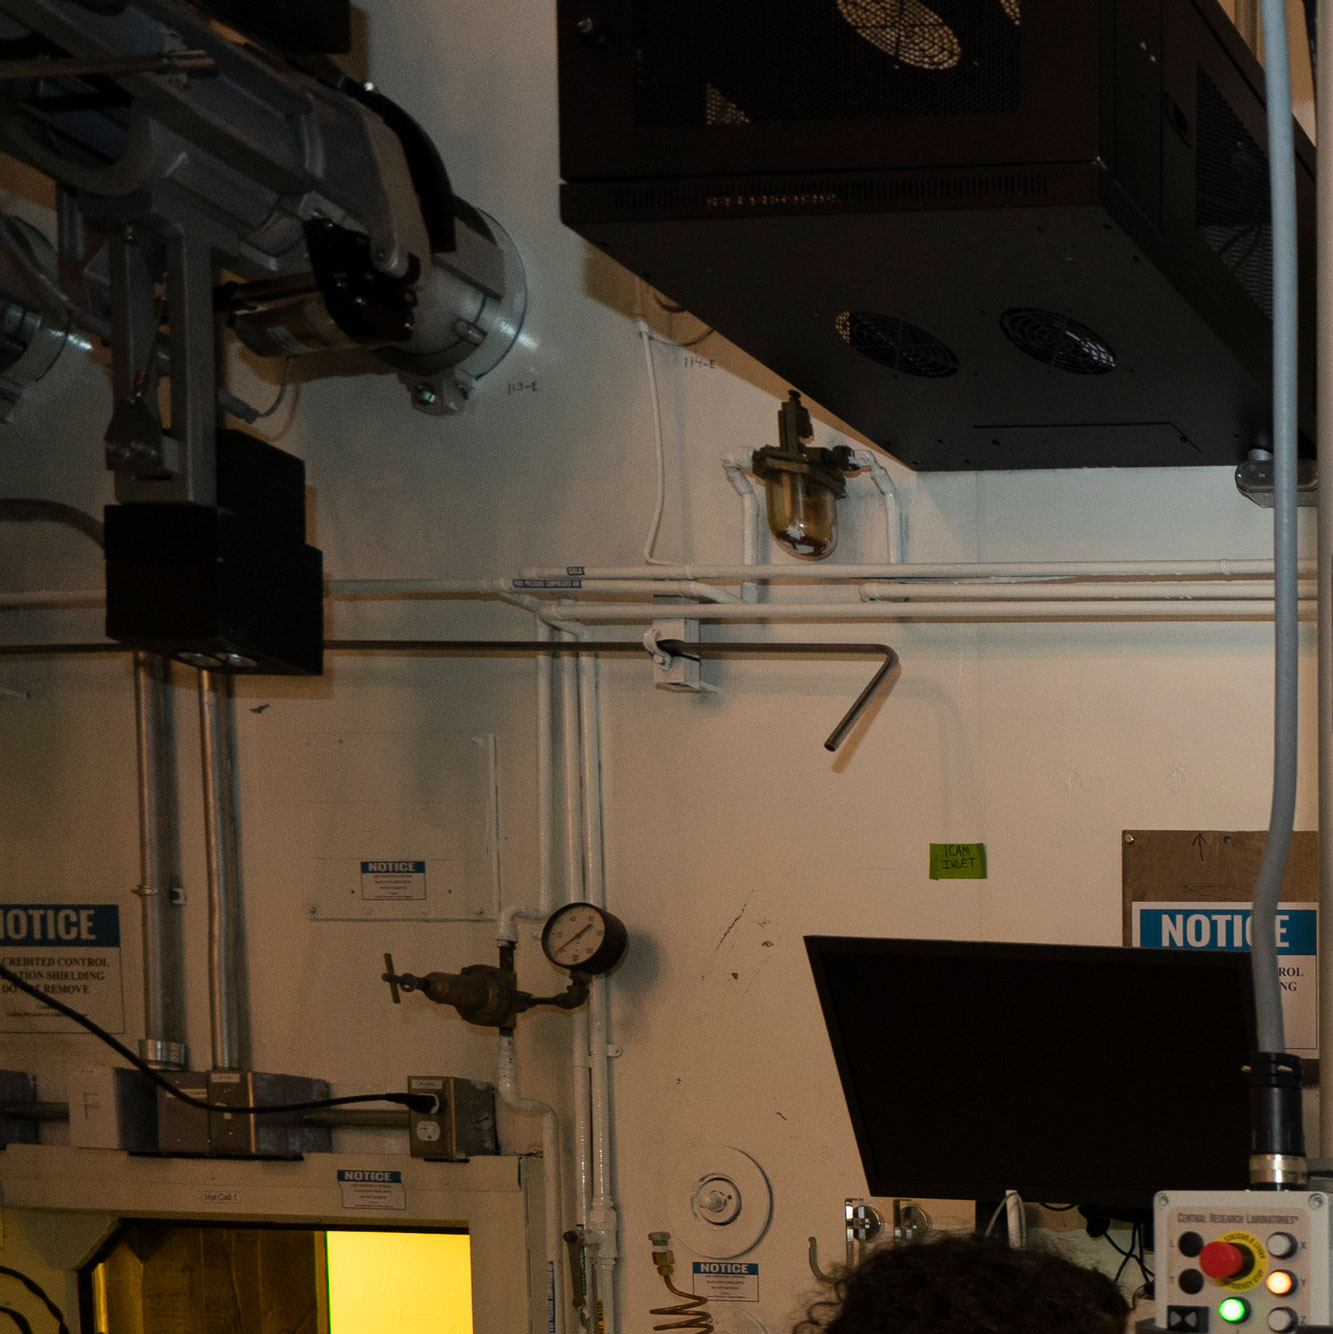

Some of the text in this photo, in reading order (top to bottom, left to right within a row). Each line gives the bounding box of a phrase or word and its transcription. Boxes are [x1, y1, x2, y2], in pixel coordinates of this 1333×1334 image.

[368, 862, 416, 872] NOTICE
[1161, 914, 1290, 948] NOTIE
[57, 957, 110, 967] CONTROL
[46, 971, 105, 981] SHIELDING
[44, 984, 91, 994] REMOVE
[344, 1171, 392, 1182] NOTICE
[700, 1263, 749, 1274] NOTICE
